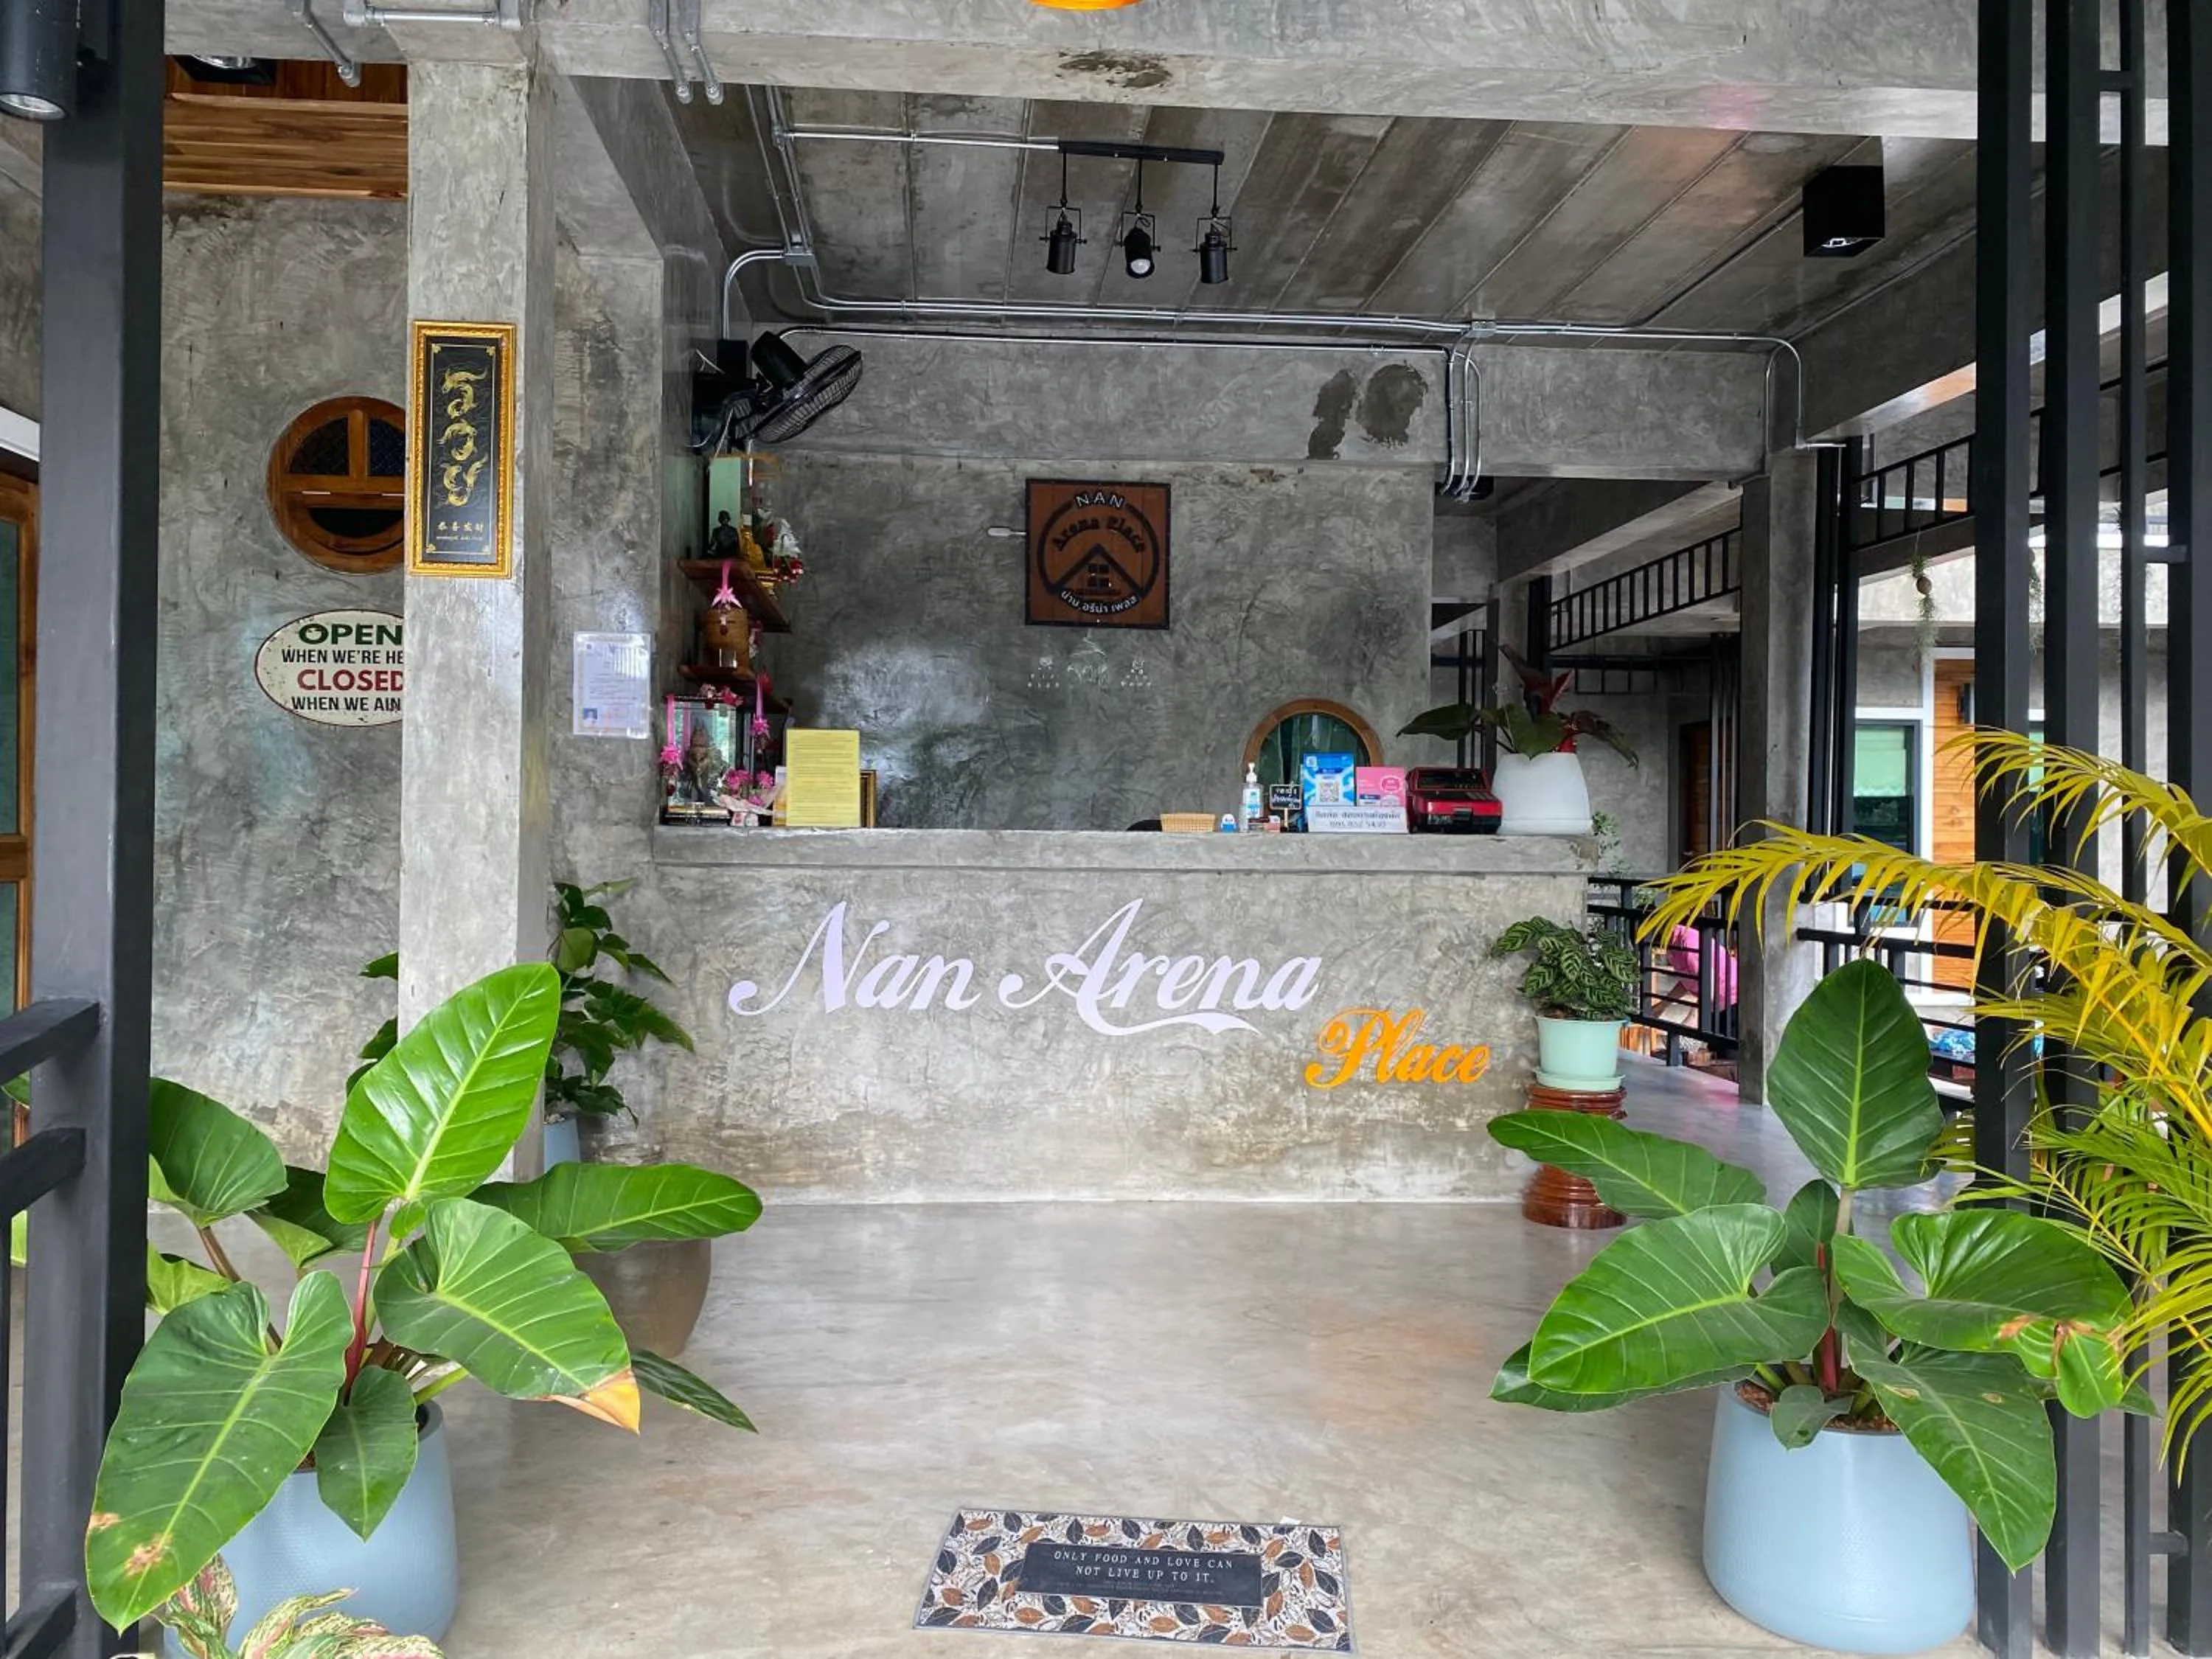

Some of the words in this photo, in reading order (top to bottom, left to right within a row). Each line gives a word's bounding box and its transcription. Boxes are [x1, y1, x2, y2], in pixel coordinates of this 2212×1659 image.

[1076, 492, 1124, 508] NAN
[299, 623, 403, 646] OPEN
[282, 648, 327, 663] WHEN
[333, 650, 380, 664] WE'RE
[297, 669, 403, 691] CLOSED
[292, 696, 339, 710] WHEN
[344, 697, 369, 711] WE
[728, 900, 981, 1016] Nan
[998, 897, 1322, 1036] Arena
[1304, 1008, 1492, 1090] Place
[1054, 1551, 1088, 1562] ONLY
[1095, 1554, 1127, 1564] FOOD
[1135, 1556, 1160, 1566] AND
[1167, 1557, 1200, 1568] LOVE
[1207, 1559, 1233, 1569] CAN
[1075, 1566, 1101, 1576] NOT
[1108, 1567, 1139, 1579] LIVE
[1148, 1570, 1164, 1579] UP
[1172, 1571, 1188, 1582] TO
[1195, 1573, 1214, 1583] IT.
